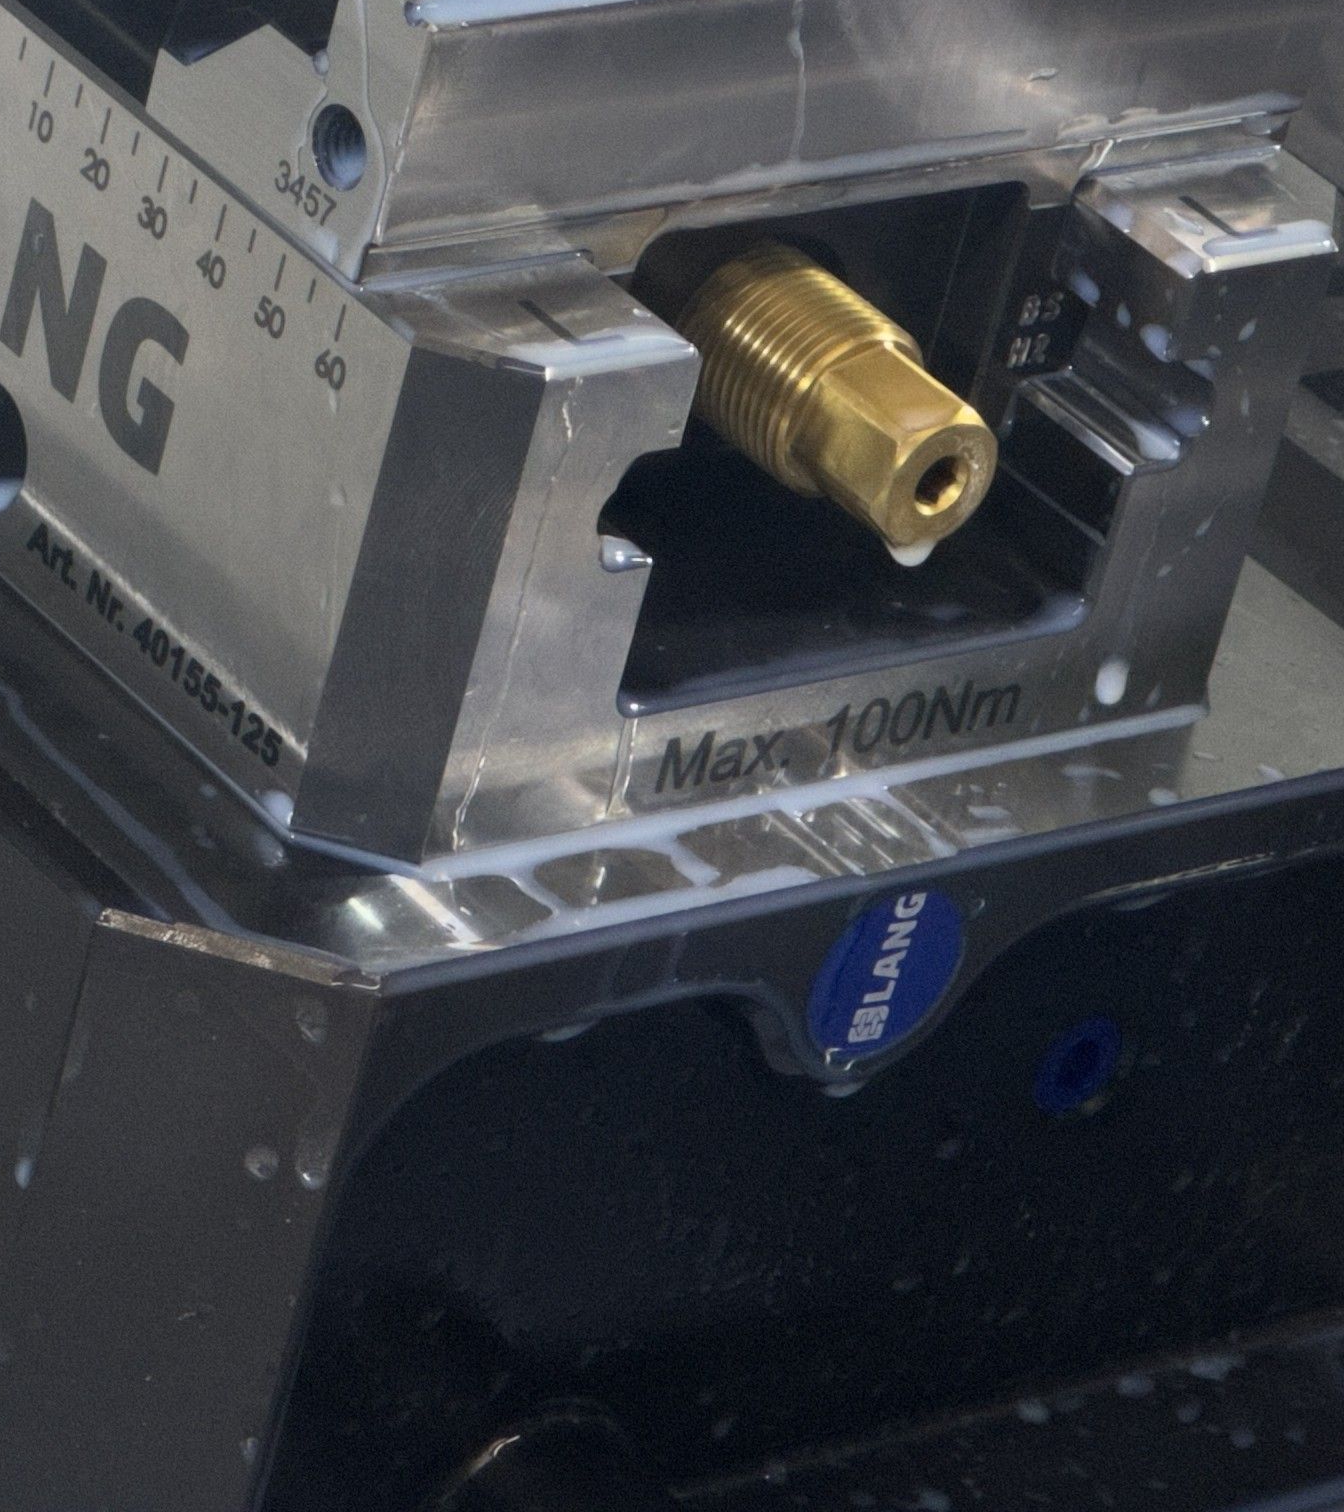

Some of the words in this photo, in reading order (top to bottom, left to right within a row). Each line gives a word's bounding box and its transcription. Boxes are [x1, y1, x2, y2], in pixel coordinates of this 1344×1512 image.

[28, 99, 54, 143] 10
[80, 147, 110, 191] 20
[137, 195, 168, 239] 30
[195, 249, 226, 289] 40
[254, 295, 286, 339] 50
[314, 348, 347, 390] 60
[274, 159, 338, 227] 3457
[25, 522, 78, 592] Art.
[84, 568, 125, 633] Nr.
[132, 617, 284, 768] 40155-125
[656, 730, 791, 794] Max.
[826, 679, 1021, 759] 100Nm
[863, 892, 928, 1004] LANG
